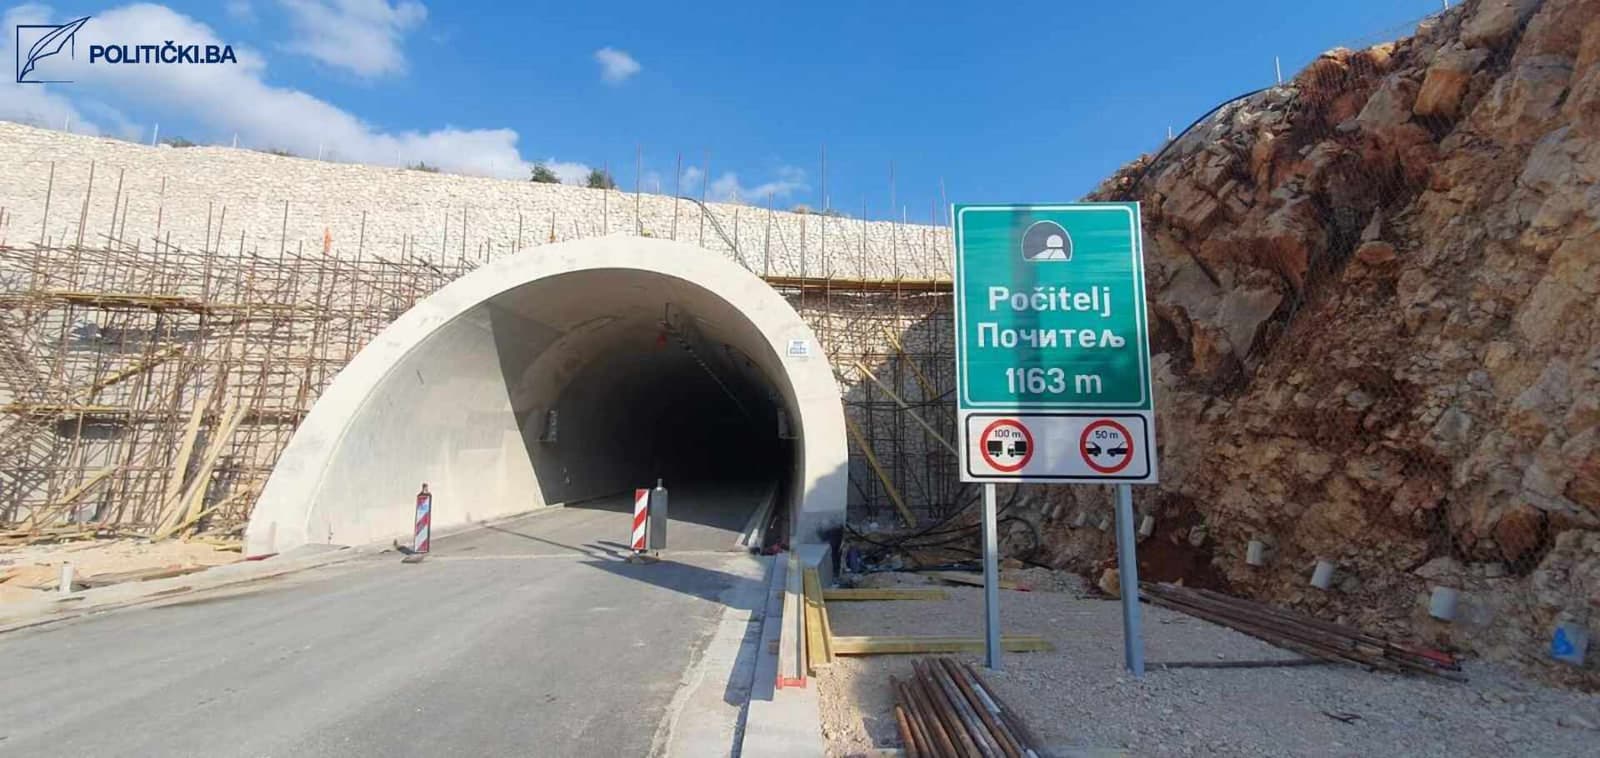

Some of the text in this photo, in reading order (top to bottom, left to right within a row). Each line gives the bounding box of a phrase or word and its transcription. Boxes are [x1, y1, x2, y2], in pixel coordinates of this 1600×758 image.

[988, 286, 1111, 317] Počitelj
[977, 322, 1126, 348] Почитељ
[1006, 368, 1102, 394] 1163 m
[994, 429, 1021, 438] 100 m
[1095, 430, 1119, 439] 50 m
